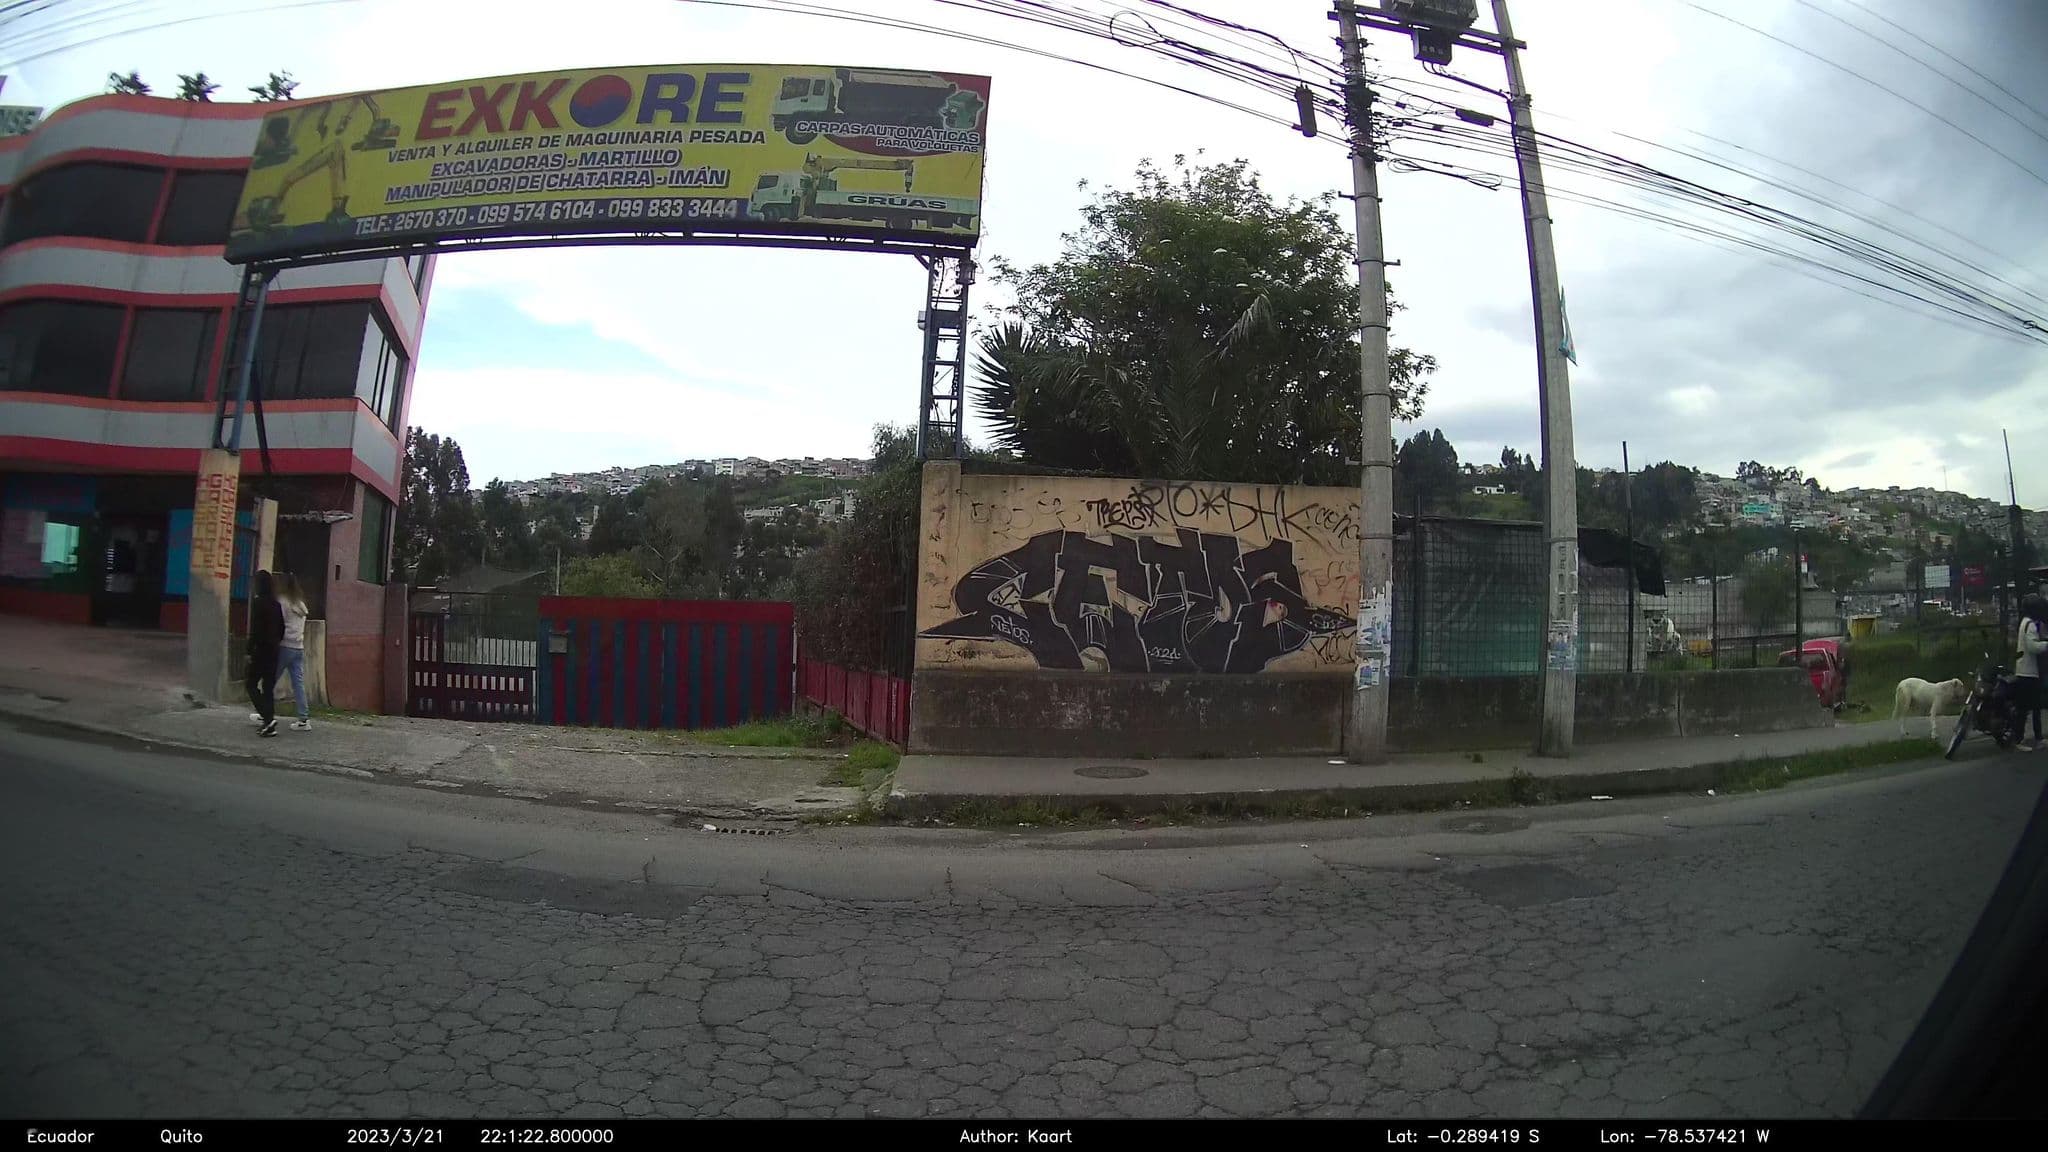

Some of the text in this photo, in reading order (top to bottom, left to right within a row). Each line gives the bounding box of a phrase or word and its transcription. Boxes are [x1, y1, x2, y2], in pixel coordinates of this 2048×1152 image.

[414, 72, 750, 142] EXKORE
[388, 130, 766, 163] VENTA Y ALQUILER DE MAQUINARIA PESADA
[796, 121, 980, 144] CARPAS AUTOMÁTICAS
[876, 138, 979, 153] PARA VOLQUETAS
[430, 152, 568, 178] EXCAVADORAS
[578, 148, 682, 169] MARTILLO
[385, 176, 513, 202] MANIPULADOR
[515, 173, 543, 191] DE
[544, 170, 653, 190] CHATARRA
[667, 166, 726, 186] IMÁN
[394, 211, 434, 231] 2670
[435, 207, 469, 227] 370
[477, 204, 510, 224] 099
[512, 202, 546, 221] 574
[550, 200, 595, 219] 6104
[608, 200, 643, 218] 099
[647, 200, 684, 217] 833
[688, 200, 738, 218] 3444
